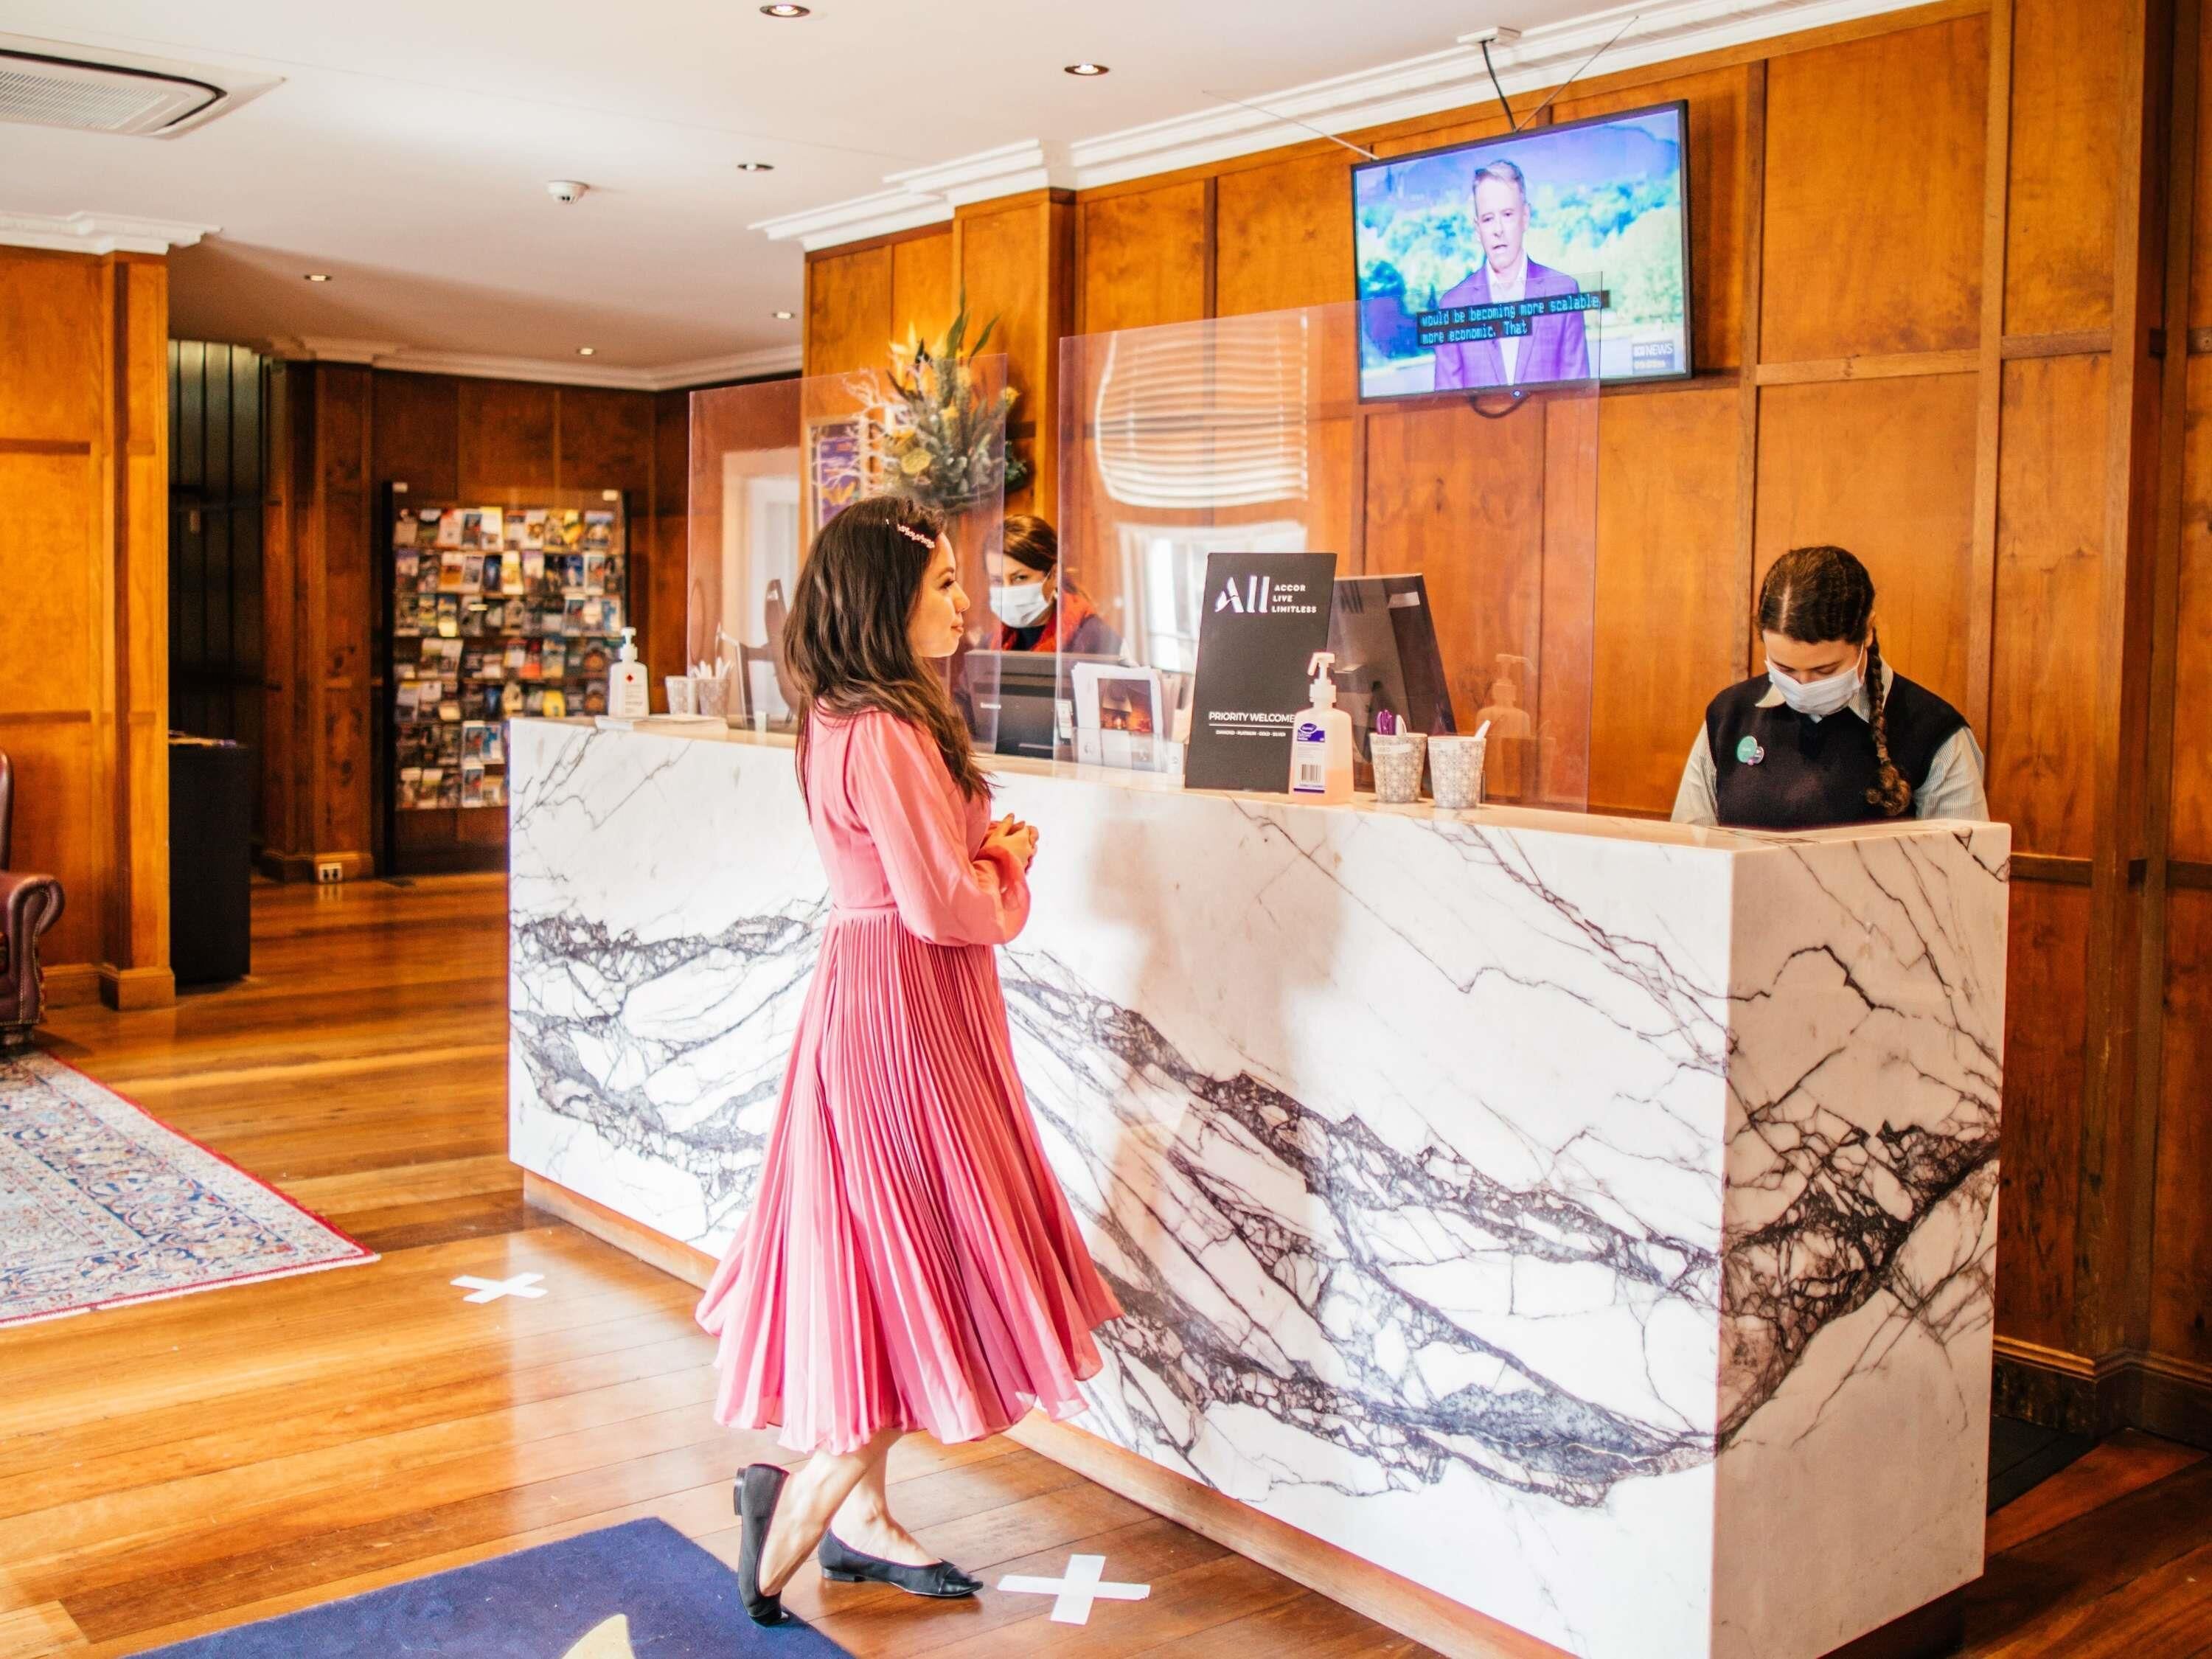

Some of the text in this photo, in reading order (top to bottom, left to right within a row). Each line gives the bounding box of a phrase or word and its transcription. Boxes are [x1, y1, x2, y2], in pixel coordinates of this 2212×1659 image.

[1422, 311, 1449, 326] would
[1453, 309, 1466, 323] be
[1470, 305, 1515, 321] becoming
[1520, 303, 1544, 314] more
[1422, 332, 1444, 344] more
[1503, 321, 1528, 335] That
[1645, 342, 1673, 356] NEWS
[1215, 575, 1270, 613] All
[1271, 605, 1317, 613] LIMITLESS
[1209, 712, 1295, 723] PRIORITY WELCOME
